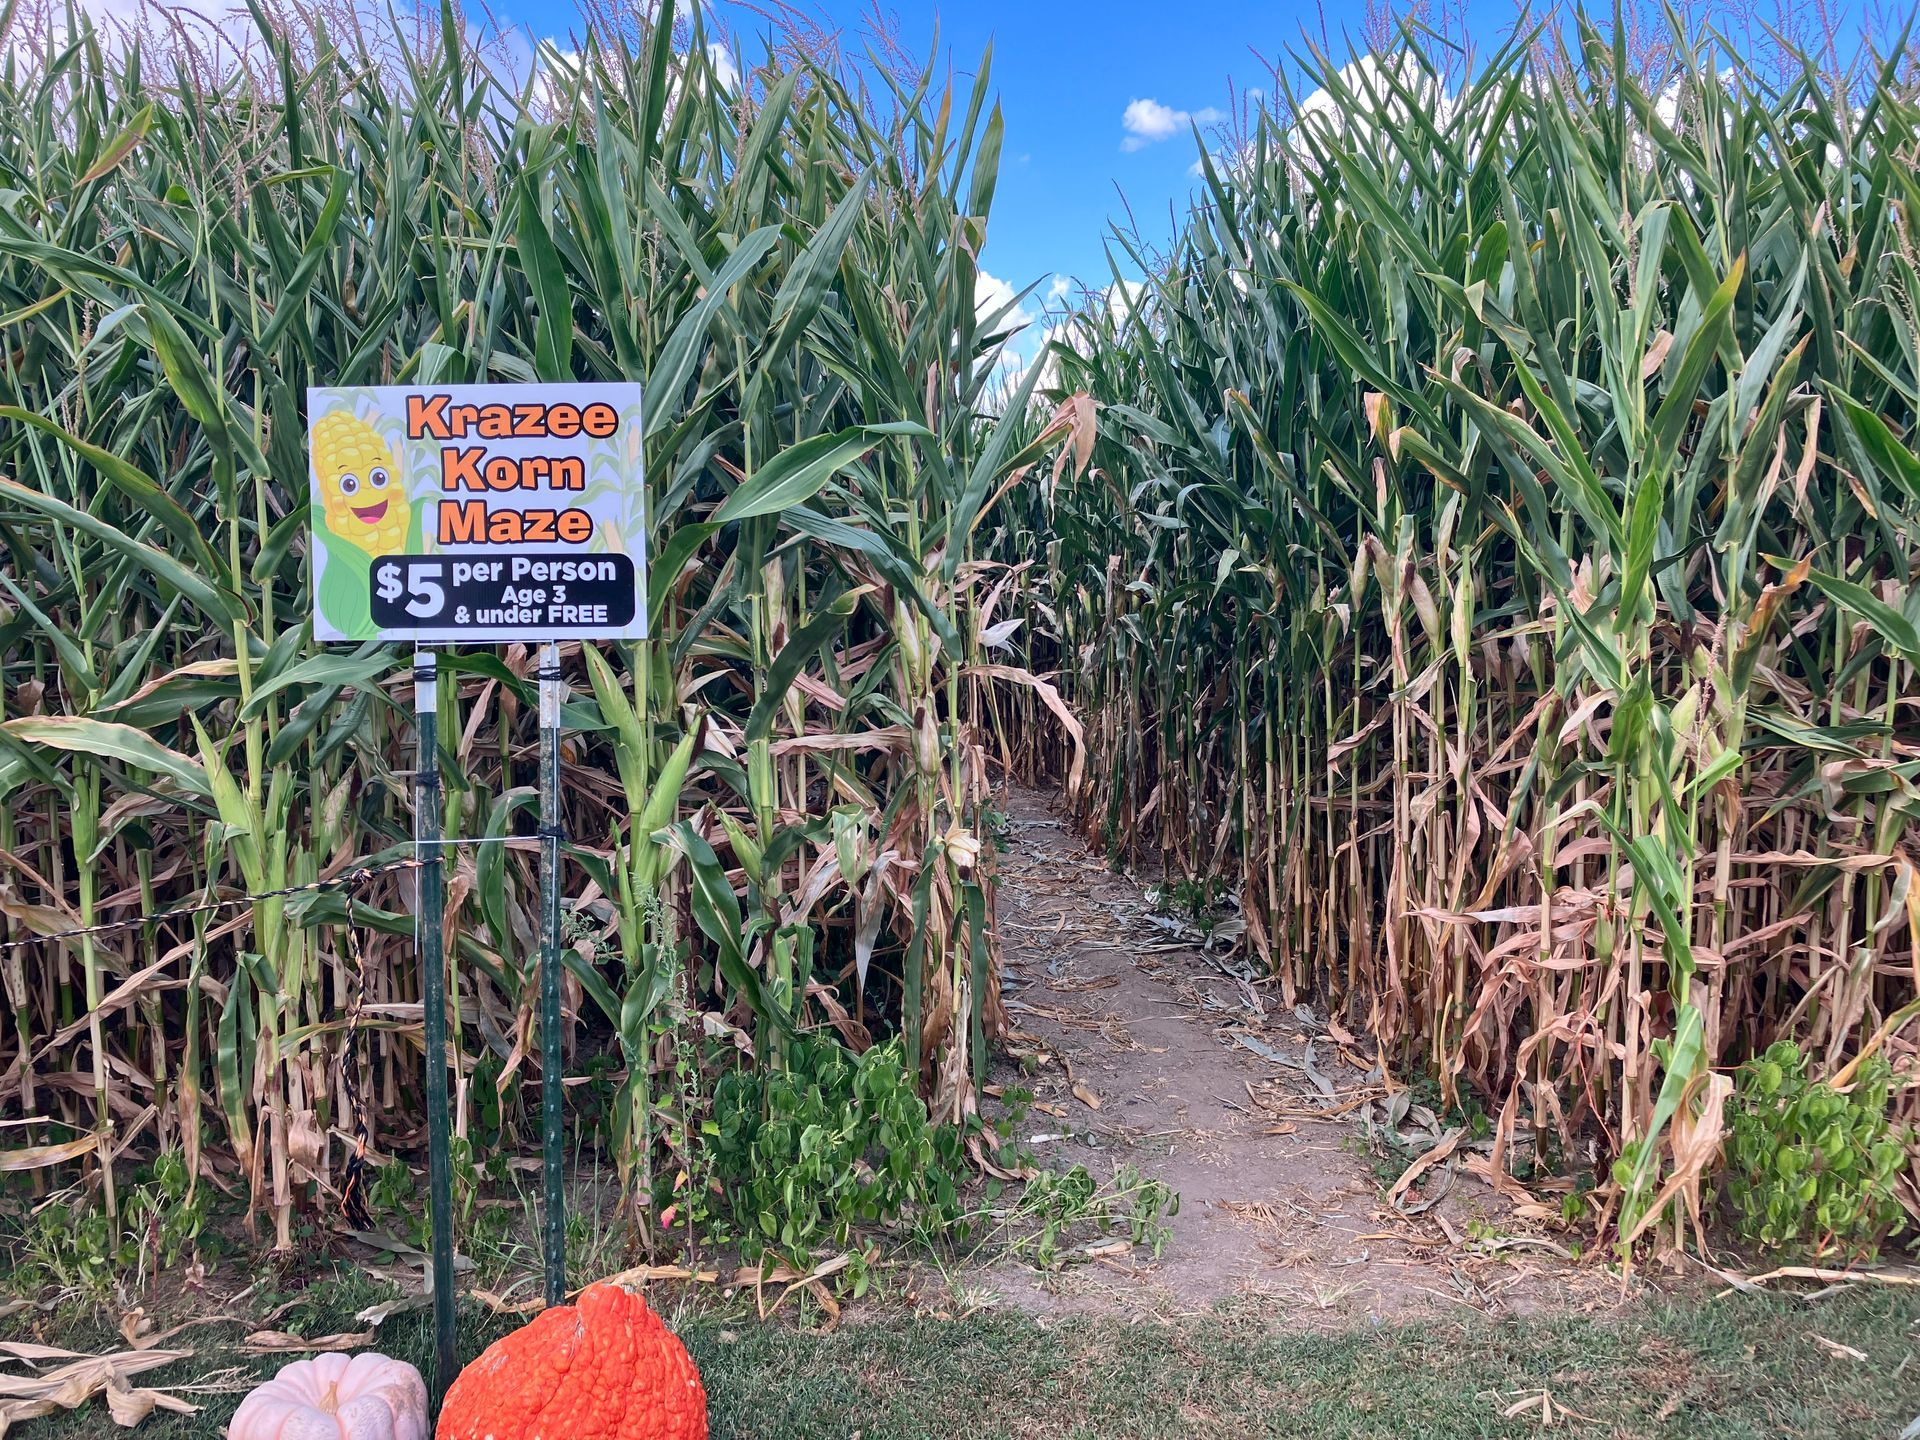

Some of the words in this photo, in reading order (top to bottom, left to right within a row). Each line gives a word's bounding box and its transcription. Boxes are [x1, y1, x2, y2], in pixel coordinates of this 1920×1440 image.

[406, 395, 619, 440] Krazee
[441, 447, 586, 492] Korn
[437, 499, 594, 545] Maze
[376, 563, 446, 618] $5
[453, 563, 504, 587] per
[511, 557, 616, 581] Person
[454, 605, 471, 624] &
[476, 605, 542, 624] under
[548, 604, 608, 623] FREE
[500, 586, 547, 606] Age
[552, 585, 567, 604] 3
